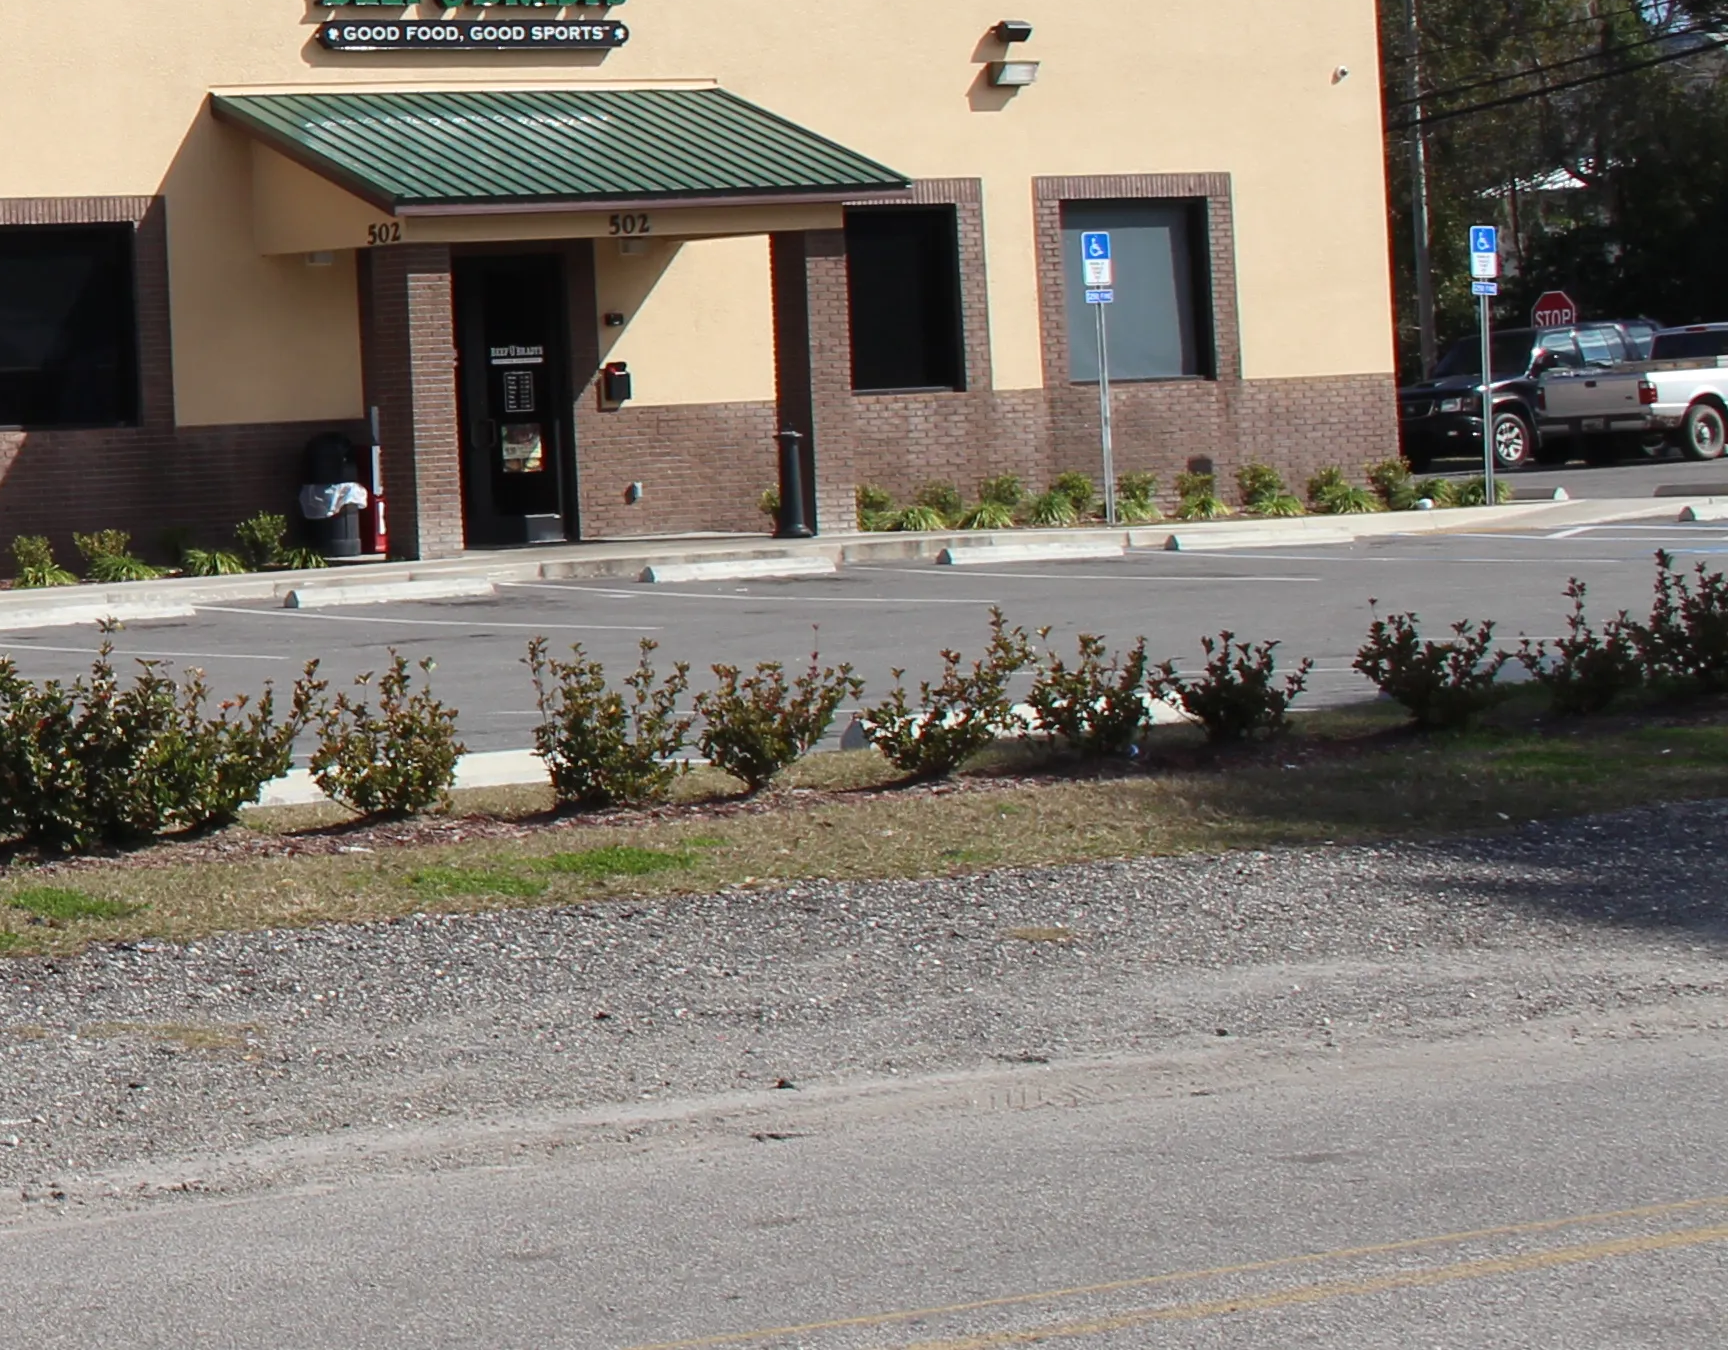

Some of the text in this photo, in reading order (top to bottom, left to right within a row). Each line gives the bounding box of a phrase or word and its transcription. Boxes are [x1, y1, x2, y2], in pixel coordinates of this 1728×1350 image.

[344, 26, 604, 42] GOOD FOOD, GOOD SPORTS
[367, 222, 401, 245] 502
[609, 214, 650, 234] 502
[1535, 309, 1571, 327] STOP
